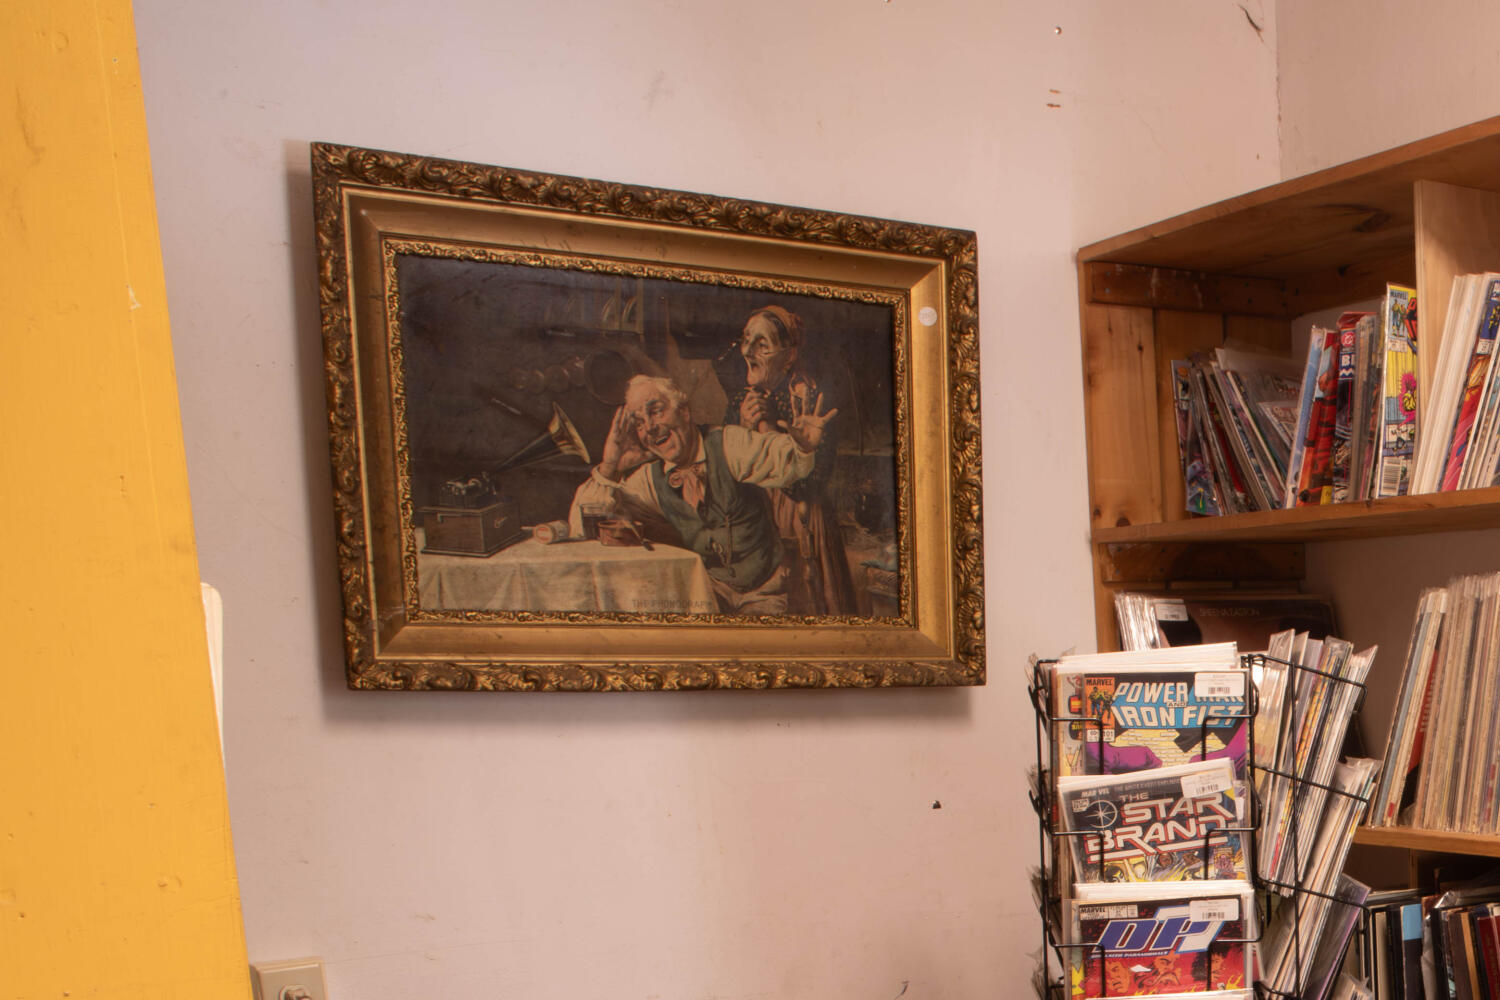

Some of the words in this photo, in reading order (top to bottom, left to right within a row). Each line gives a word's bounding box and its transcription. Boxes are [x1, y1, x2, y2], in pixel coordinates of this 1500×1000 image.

[1086, 677, 1113, 686] MARVEL
[1112, 681, 1189, 704] POWER
[1110, 705, 1177, 728] IRON
[1181, 705, 1245, 727] FIST
[1119, 792, 1150, 802] THE
[1122, 792, 1236, 825] STAR
[1086, 814, 1227, 855] BRAND
